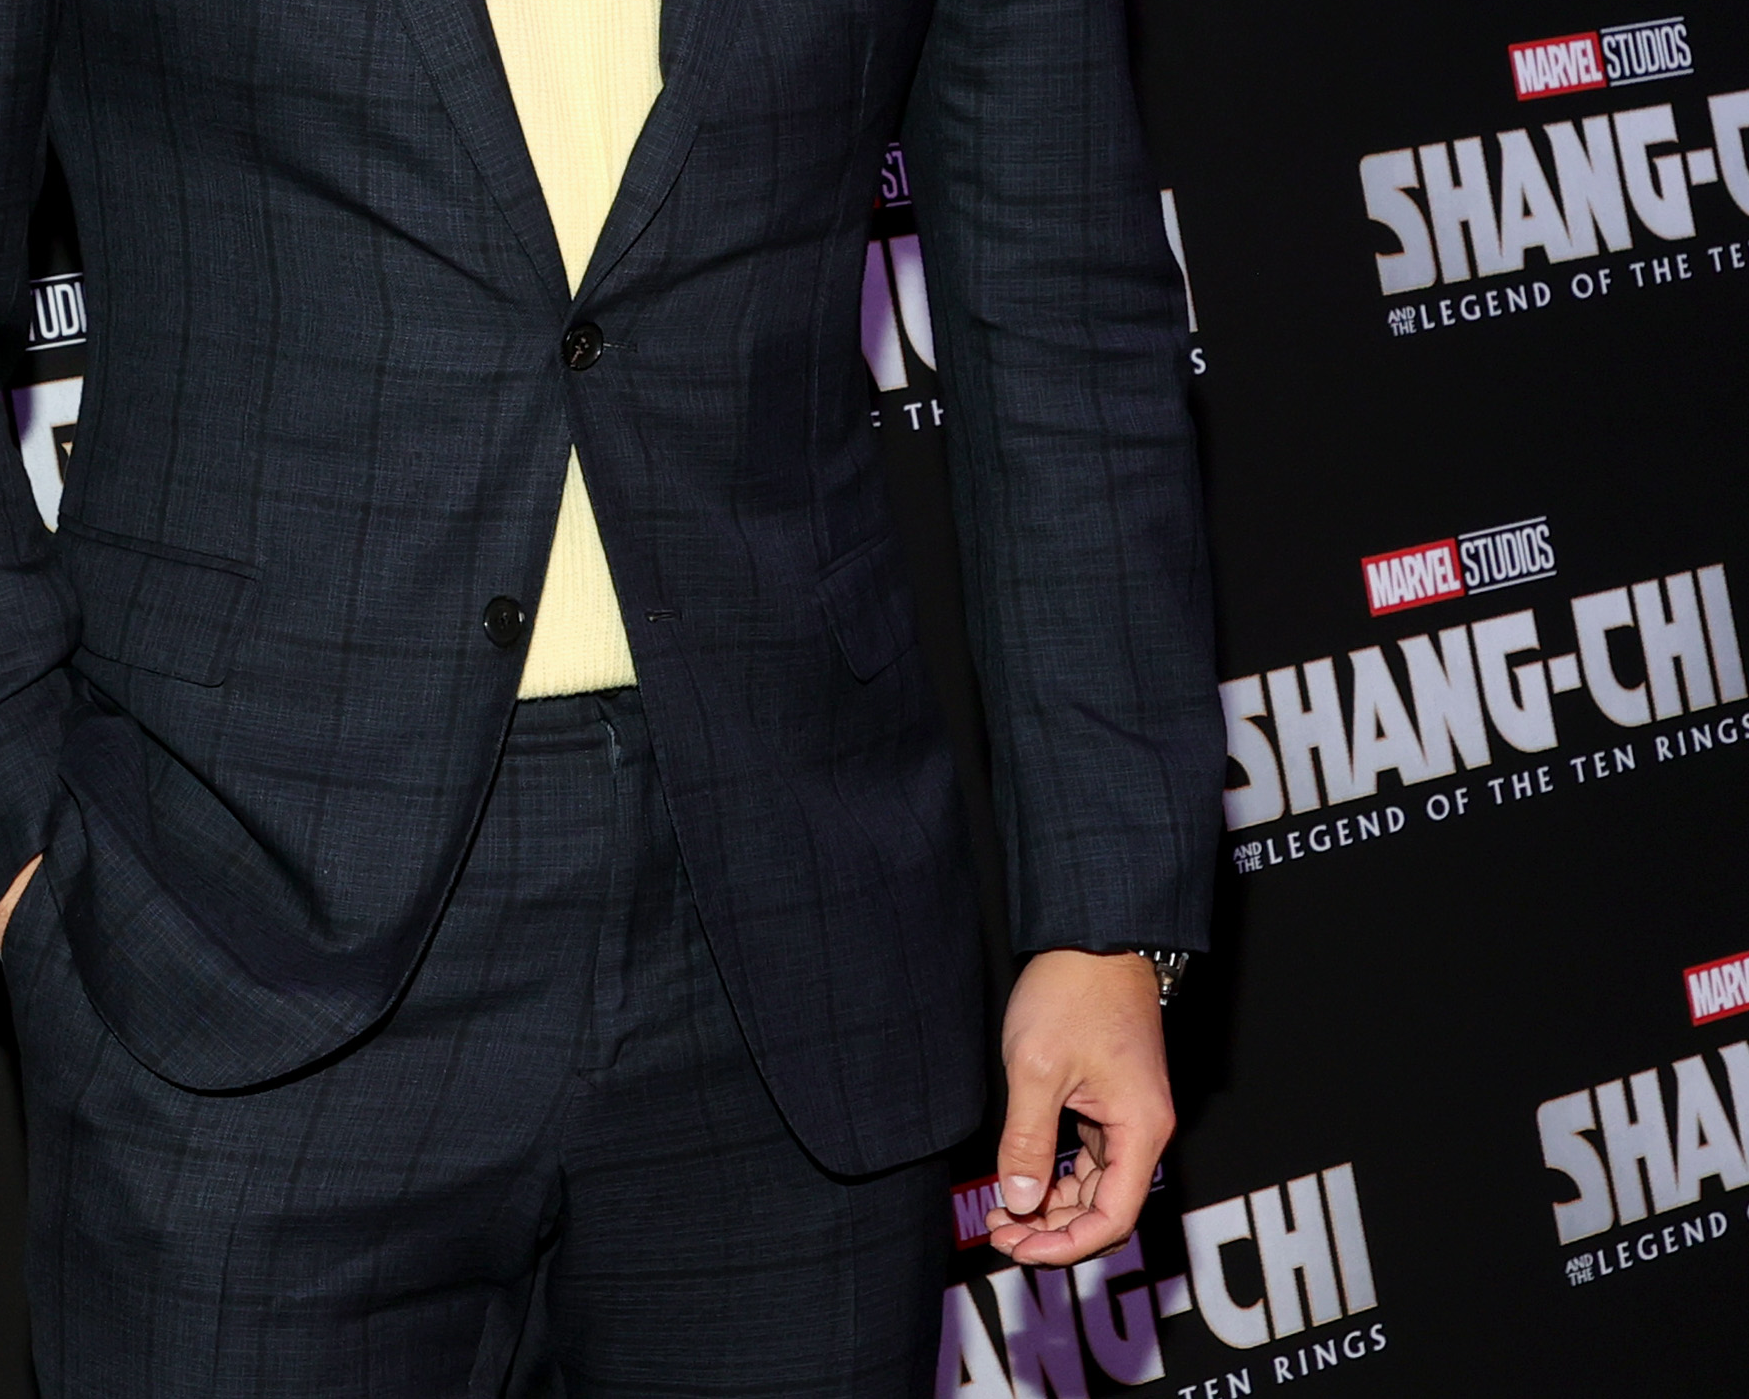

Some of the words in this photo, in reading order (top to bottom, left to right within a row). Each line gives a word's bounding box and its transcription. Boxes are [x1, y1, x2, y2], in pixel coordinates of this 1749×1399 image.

[1514, 40, 1602, 93] MARVEL
[1603, 24, 1691, 78] STUDIOS
[1421, 283, 1550, 329] LEGEND
[1572, 269, 1610, 298] OF
[1630, 254, 1691, 286] THE
[1708, 241, 1749, 272] TE
[1388, 306, 1416, 324] AND
[1391, 320, 1417, 336] THE
[1367, 547, 1460, 608] MARVEL
[1461, 525, 1554, 586] STUDIOS
[1218, 564, 1748, 831] SHANG-CHI
[1267, 807, 1404, 864] LEGEND
[1427, 788, 1468, 820] OF
[1488, 767, 1553, 804] THE
[1571, 745, 1635, 782] TEN
[1656, 714, 1749, 761] RINGS
[1233, 841, 1262, 861] AND
[1236, 855, 1263, 874] THE
[1566, 1254, 1593, 1273] AND
[1598, 1213, 1726, 1274] LEGEND
[1569, 1268, 1593, 1285] THE
[1274, 1324, 1385, 1383] RINGS
